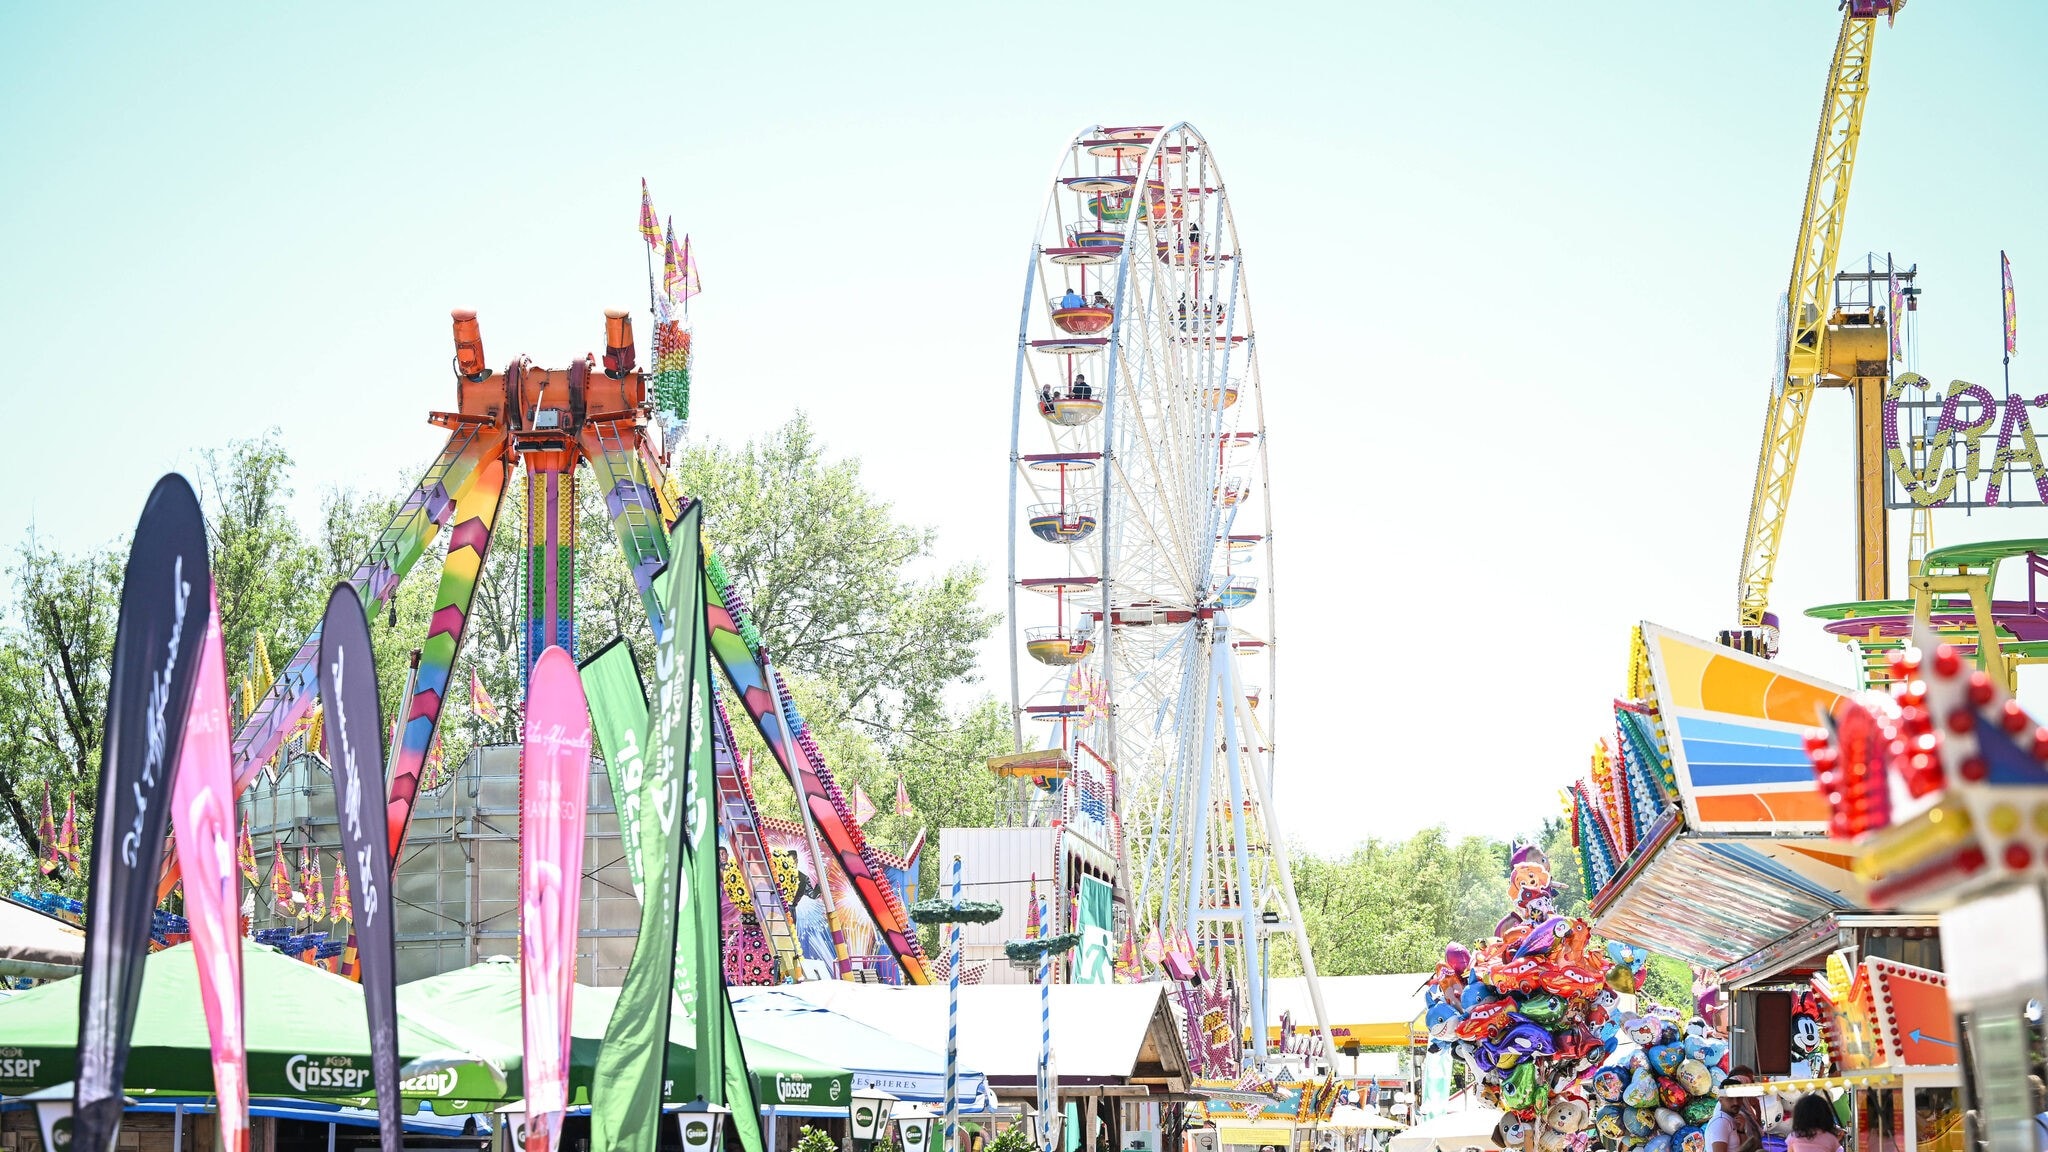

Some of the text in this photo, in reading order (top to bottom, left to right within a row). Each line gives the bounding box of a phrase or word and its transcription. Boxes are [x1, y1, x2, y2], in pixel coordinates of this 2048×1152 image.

[1883, 372, 2048, 508] CRA
[0, 1059, 41, 1078] ser
[286, 1054, 370, 1092] Gösser
[776, 1072, 812, 1103] Gösser
[876, 1080, 917, 1089] BIERES
